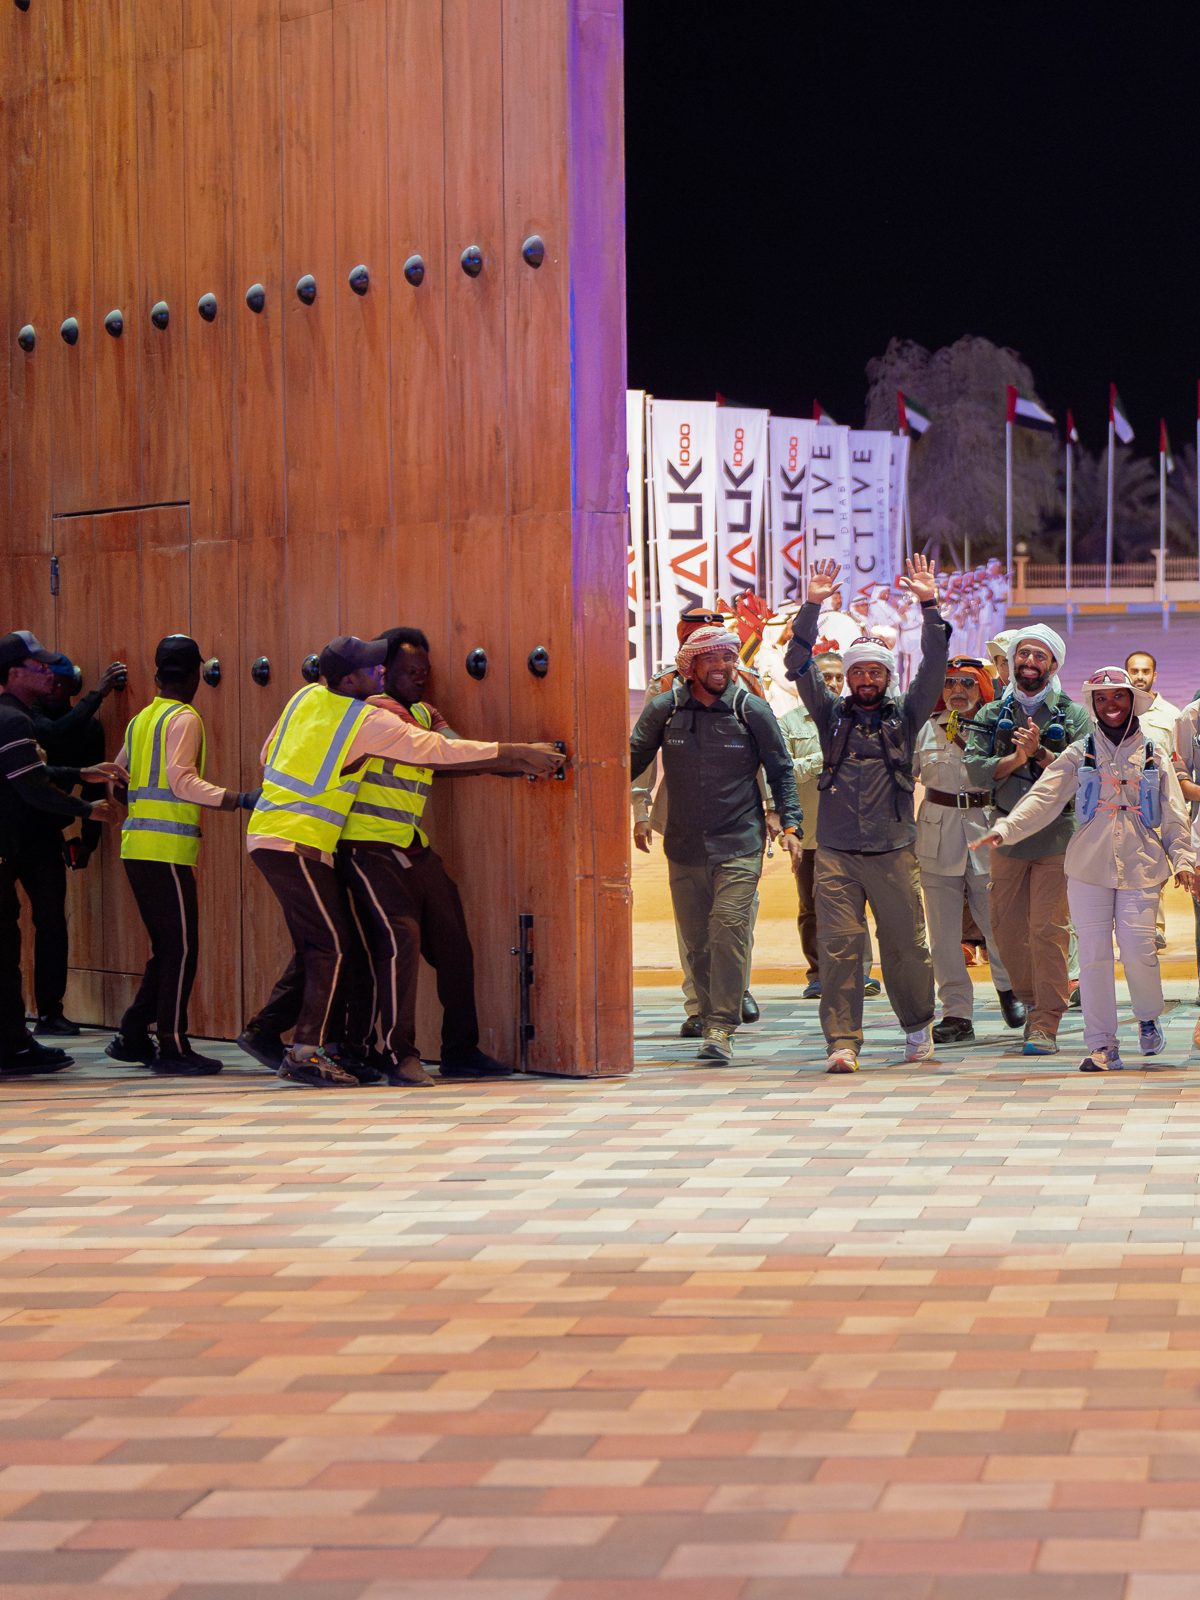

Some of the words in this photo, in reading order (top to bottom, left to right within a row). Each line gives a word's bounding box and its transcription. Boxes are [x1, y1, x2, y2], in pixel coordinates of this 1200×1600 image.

[679, 423, 691, 467] 1000
[733, 428, 744, 467] 1000
[788, 436, 798, 472] 1000
[812, 445, 835, 575] TIVE
[838, 476, 849, 534] DHABI
[852, 449, 876, 598] ACTIVE
